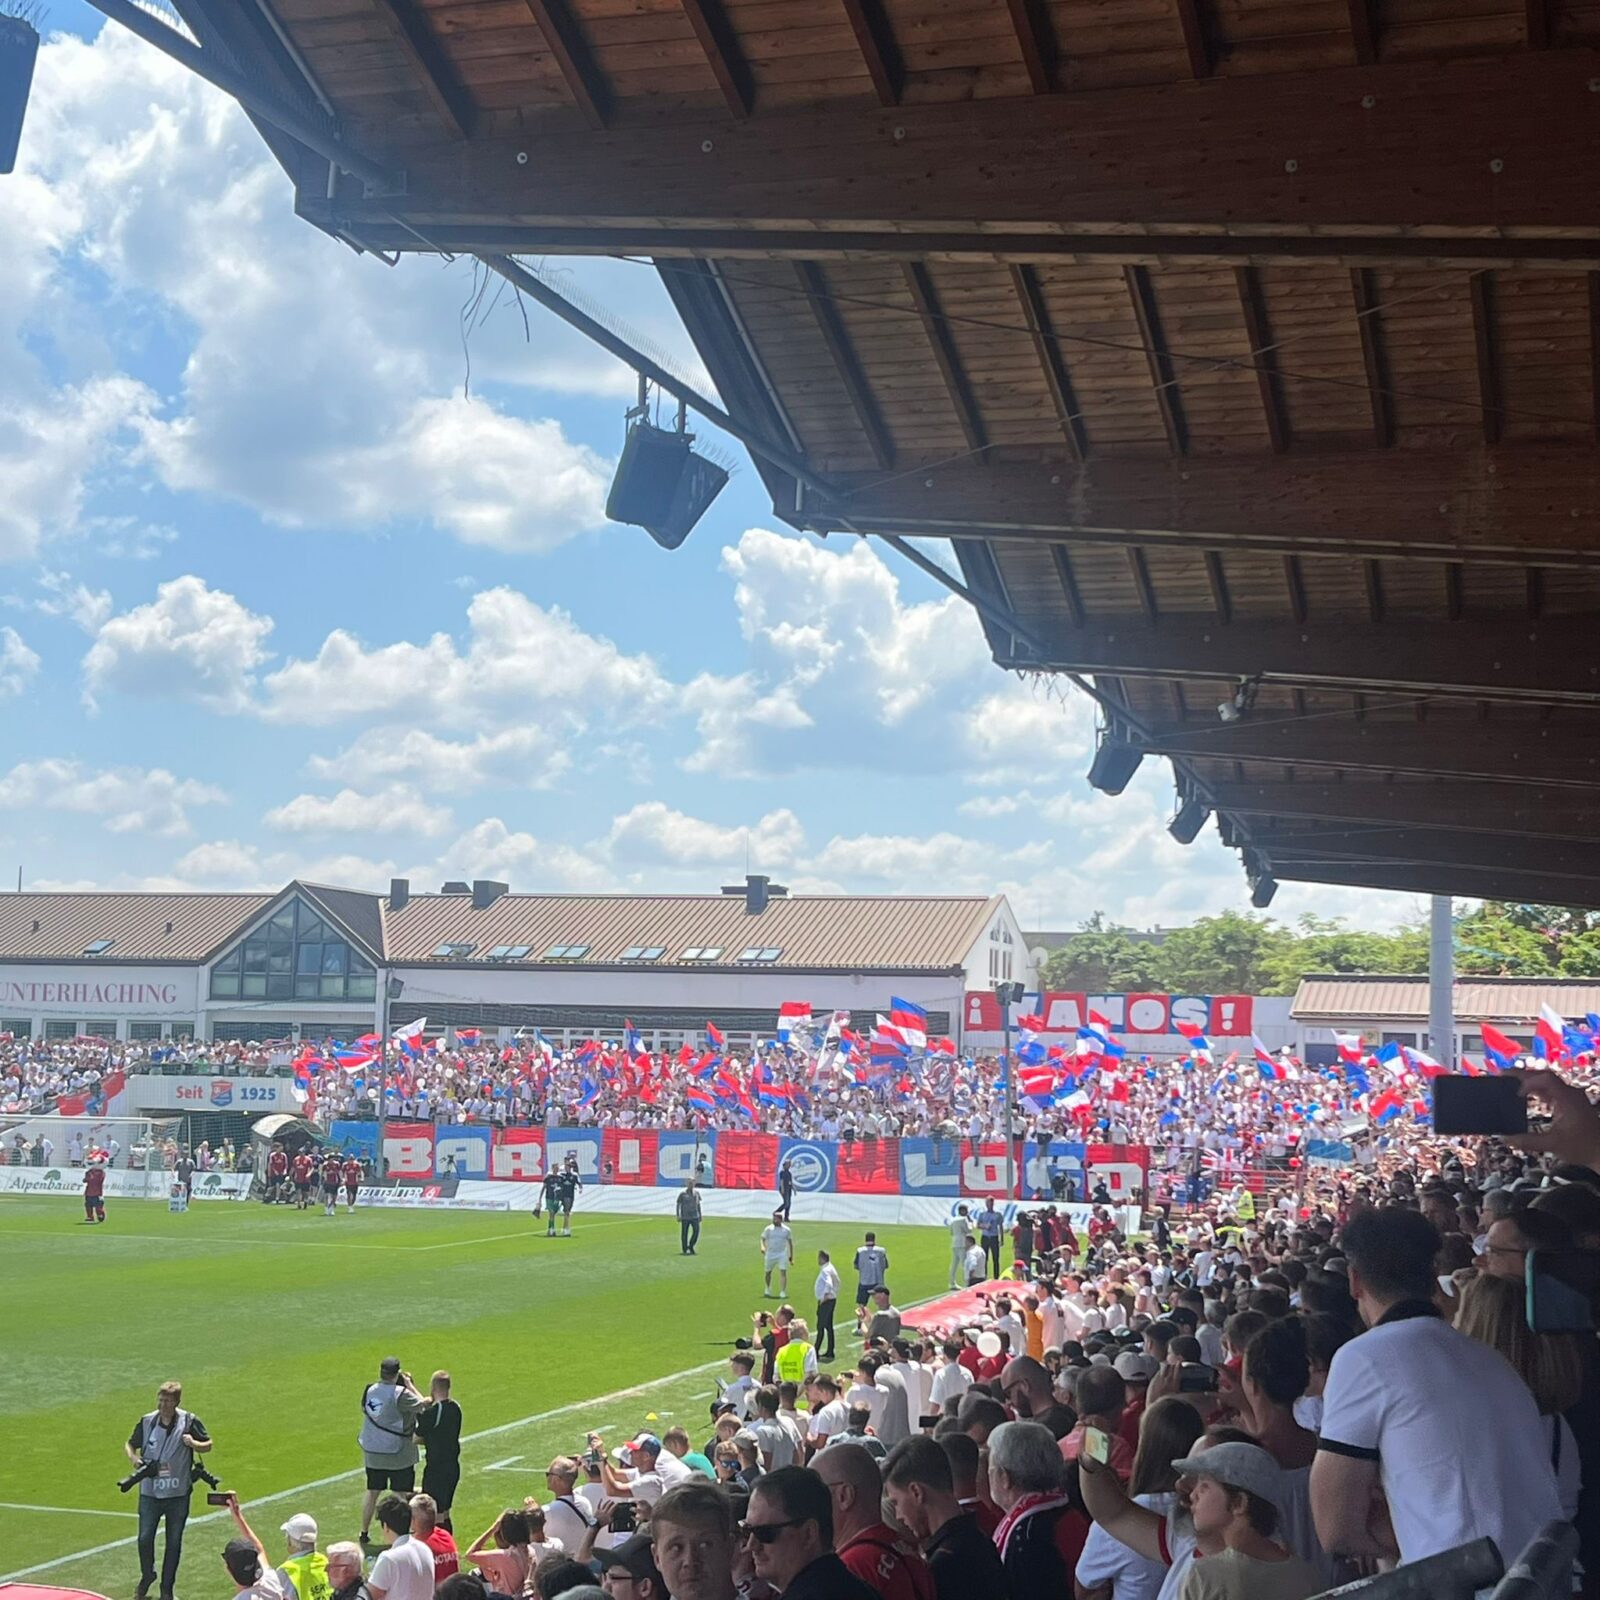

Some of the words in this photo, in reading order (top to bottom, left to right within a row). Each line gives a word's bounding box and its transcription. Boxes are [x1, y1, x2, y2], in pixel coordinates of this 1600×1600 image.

[176, 1085, 203, 1099] Seit
[241, 1087, 276, 1101] 1925
[9, 1177, 84, 1192] Alpenbauer
[153, 1477, 180, 1490] FOTO
